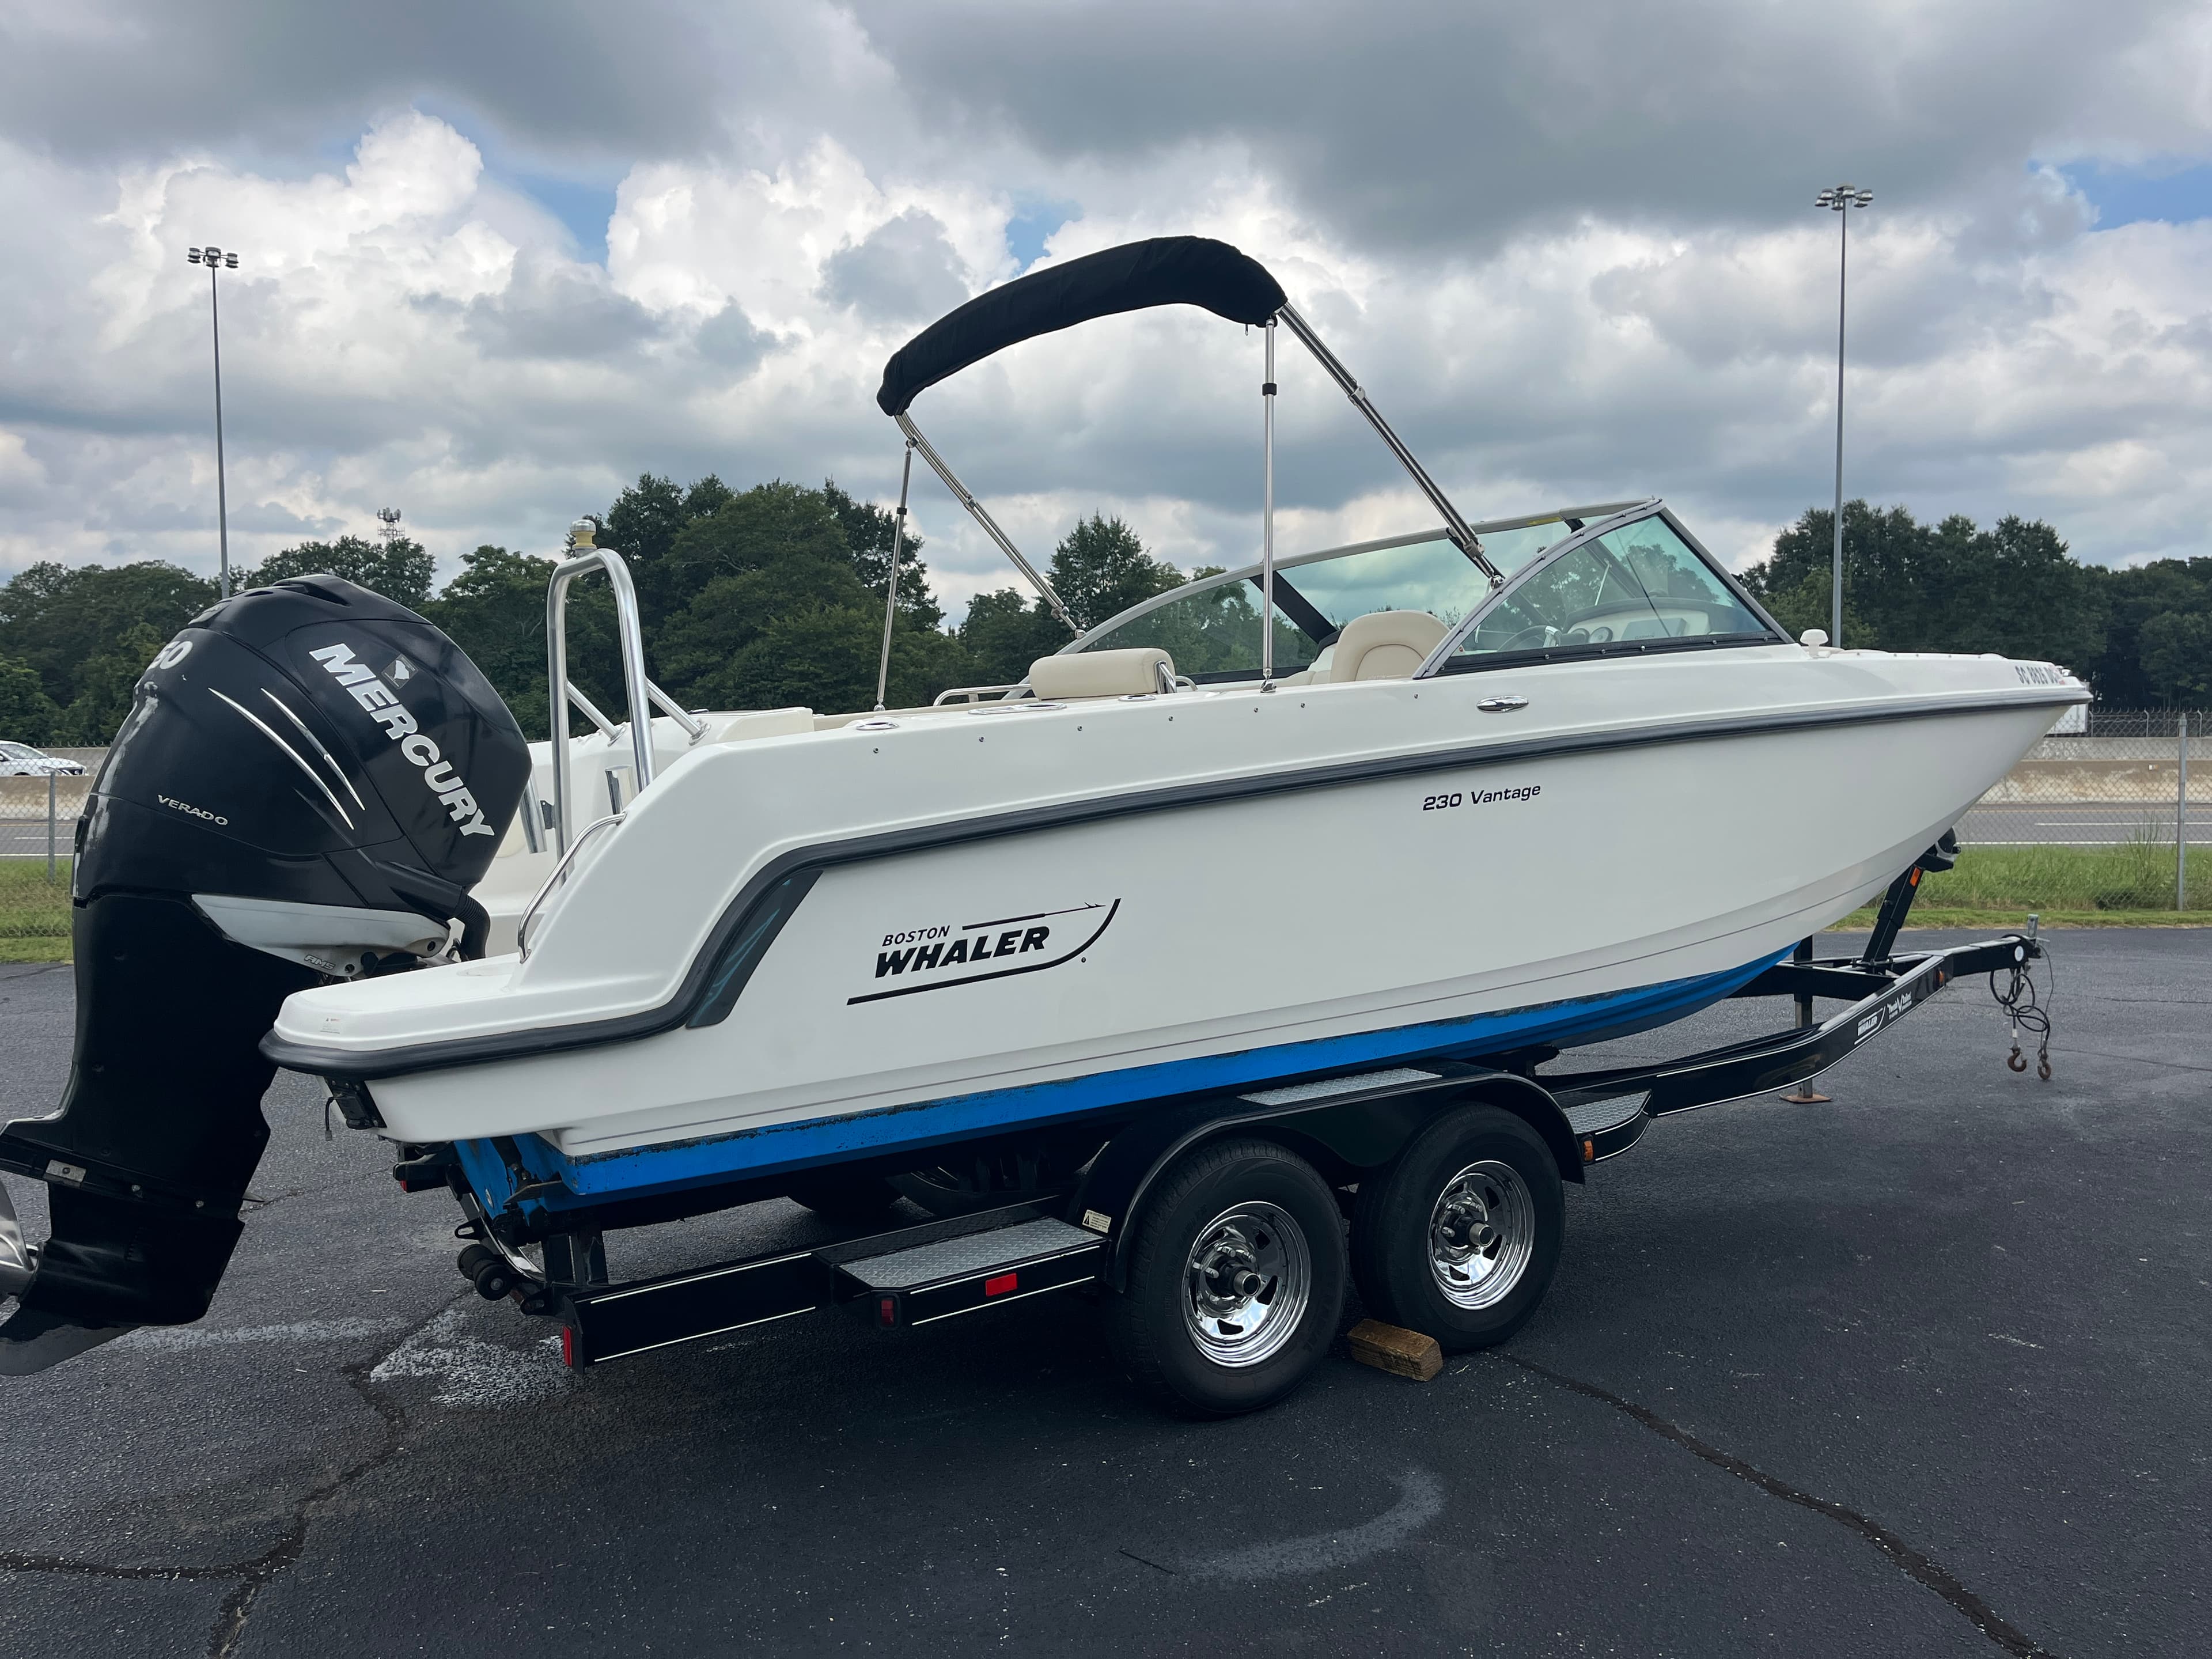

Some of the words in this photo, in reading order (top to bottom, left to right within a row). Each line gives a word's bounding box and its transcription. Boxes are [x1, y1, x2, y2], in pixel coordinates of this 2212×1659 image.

[309, 643, 495, 836] MERCURY
[157, 794, 228, 825] VERADO
[1423, 793, 1462, 811] 230
[1471, 785, 1541, 805] Vantage
[882, 925, 950, 947] BOSTON
[874, 926, 1050, 979] WHALER
